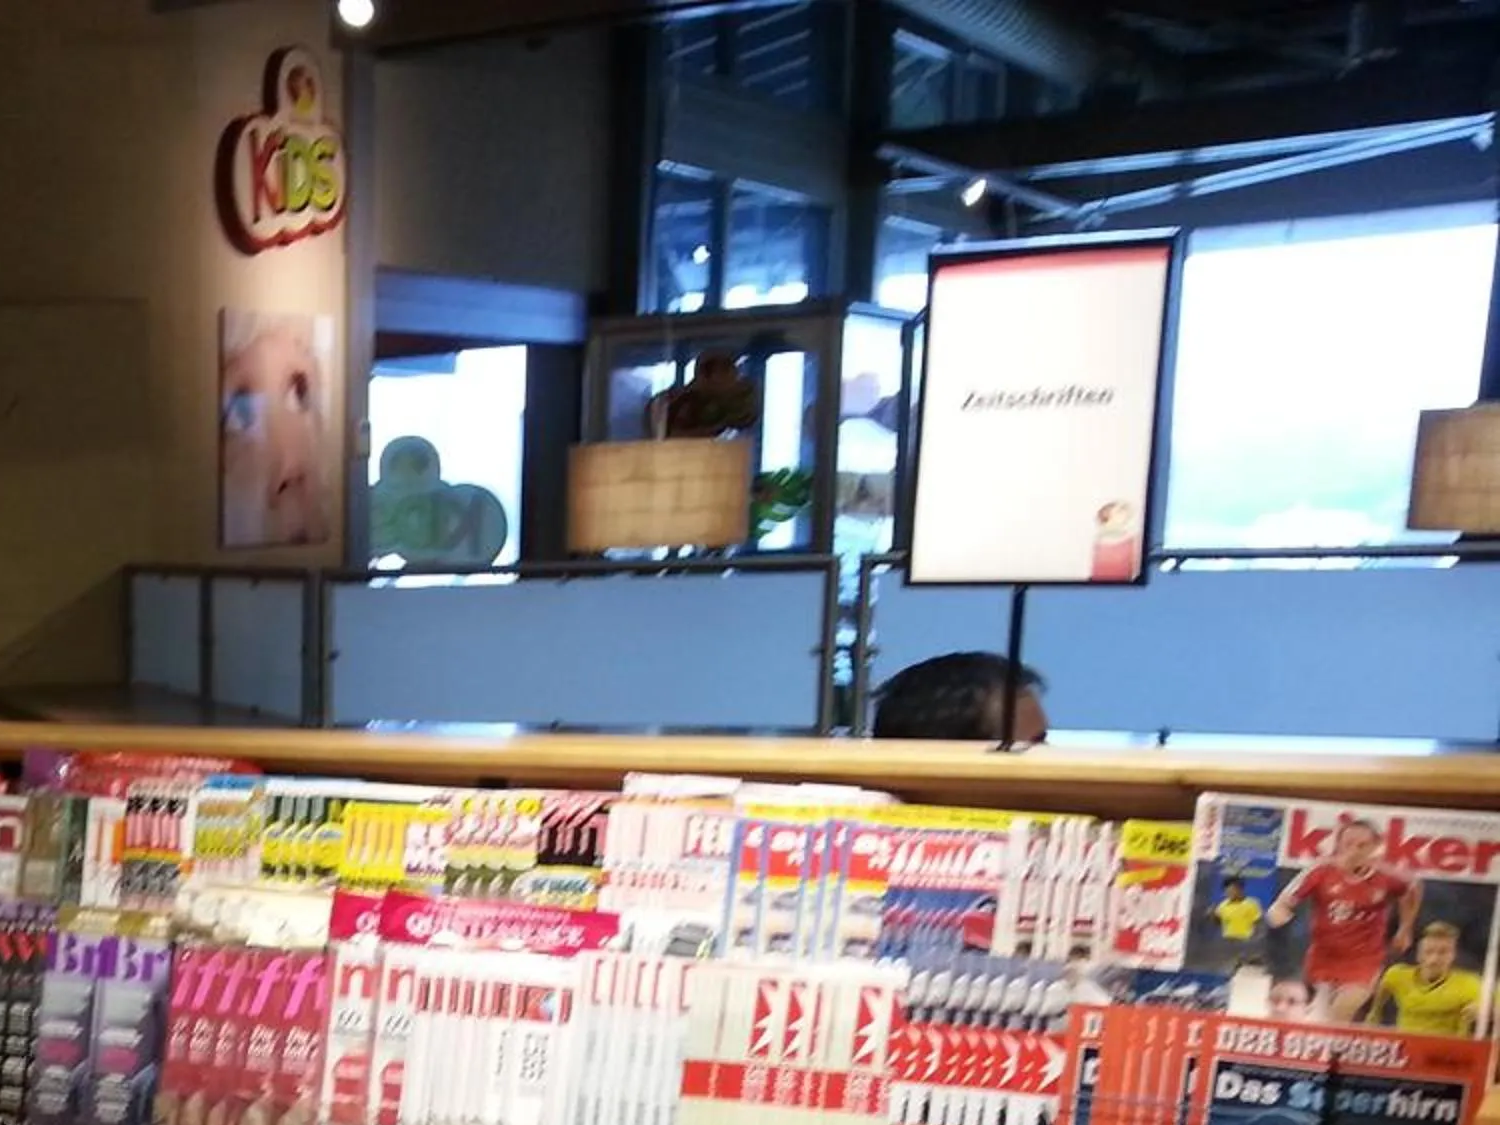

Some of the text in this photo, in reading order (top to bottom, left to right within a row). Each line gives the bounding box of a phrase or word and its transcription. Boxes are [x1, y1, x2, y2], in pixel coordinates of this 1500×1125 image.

[960, 384, 1116, 413] Zeitschriften
[1286, 808, 1500, 874] kker
[1215, 1022, 1281, 1057] DER
[1215, 1071, 1282, 1107] Das
